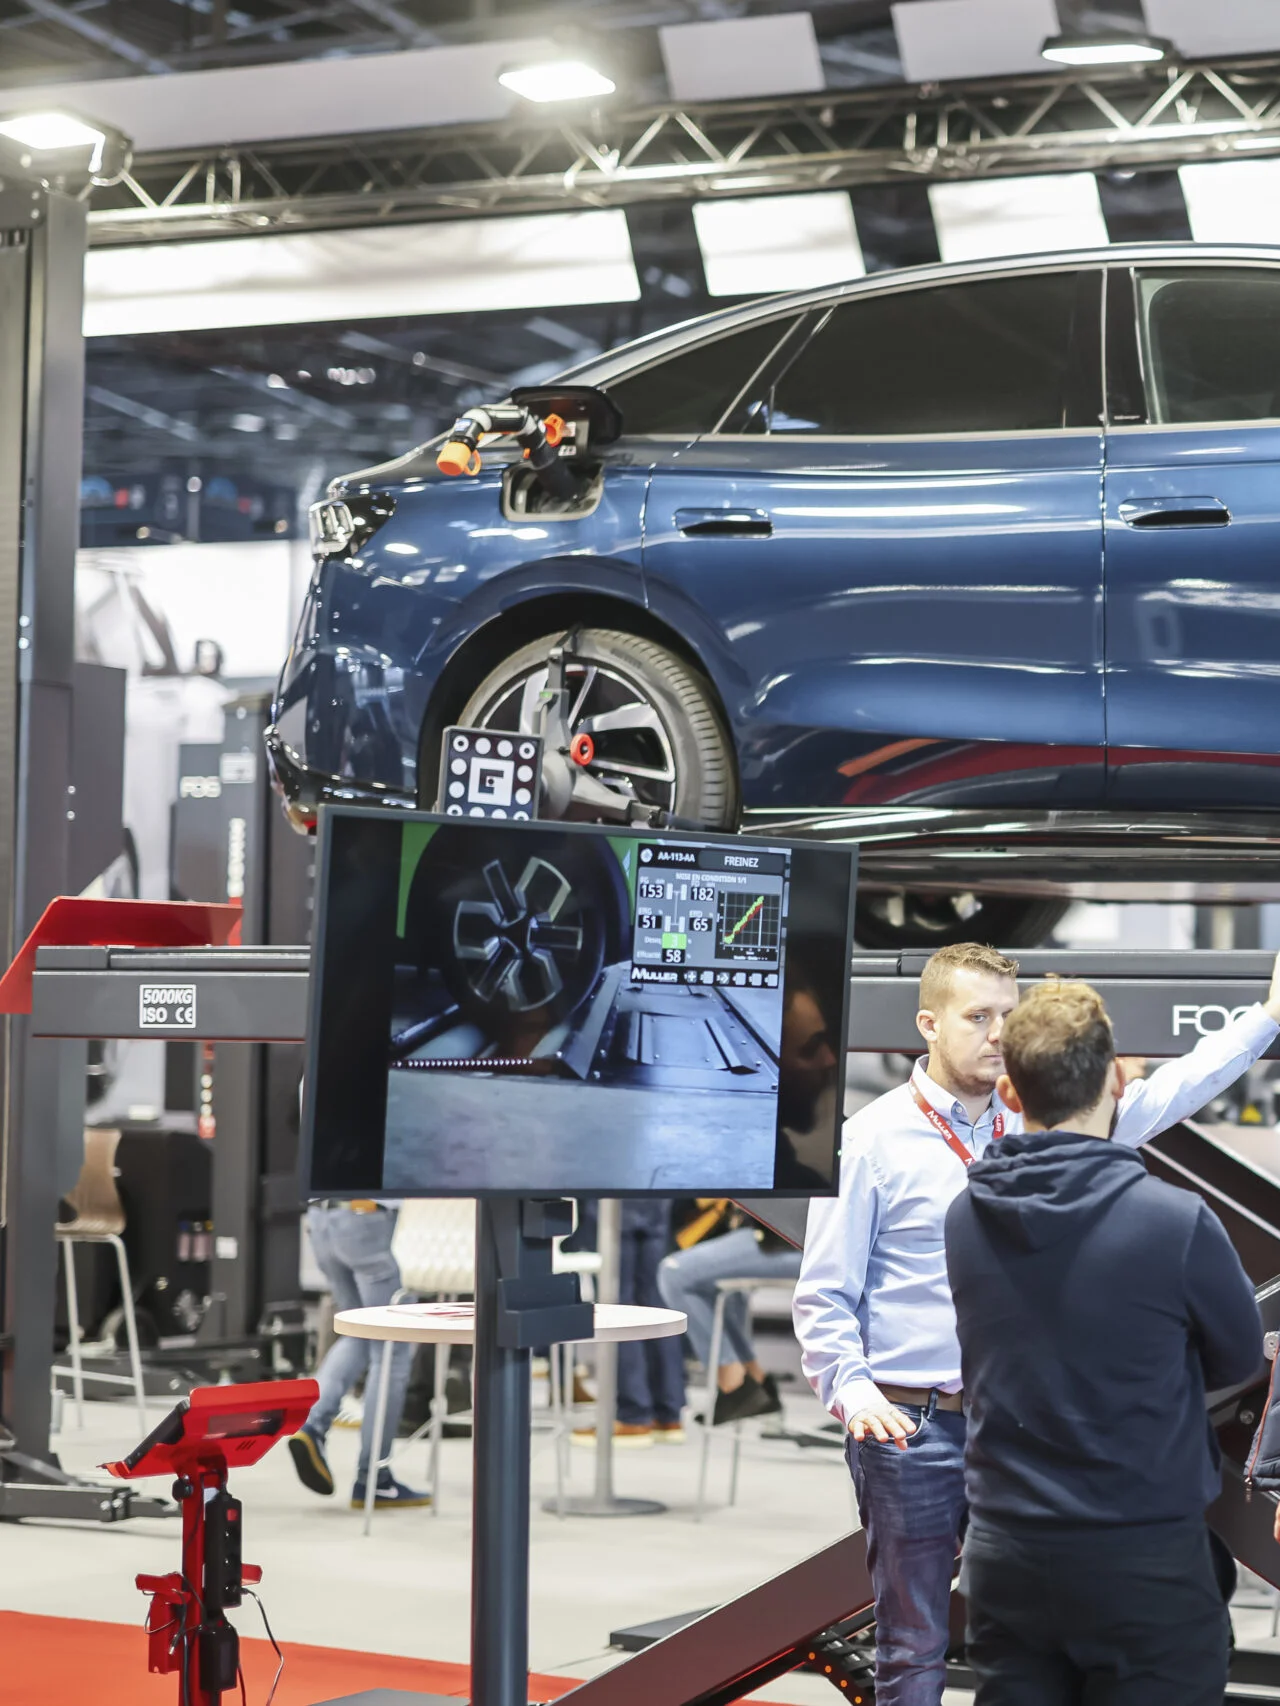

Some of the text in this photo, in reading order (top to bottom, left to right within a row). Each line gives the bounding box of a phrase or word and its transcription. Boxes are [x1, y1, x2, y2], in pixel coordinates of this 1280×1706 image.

[657, 851, 760, 868] AA-113-AA FREINEZ
[641, 884, 664, 899] 153
[692, 887, 714, 902] 182
[642, 915, 657, 929] 51
[693, 918, 709, 932] 65
[666, 949, 682, 963] 58
[631, 967, 679, 983] MULLER
[143, 988, 193, 1005] 5000KG
[143, 1006, 168, 1023] ISO
[926, 1110, 953, 1140] MULLER
